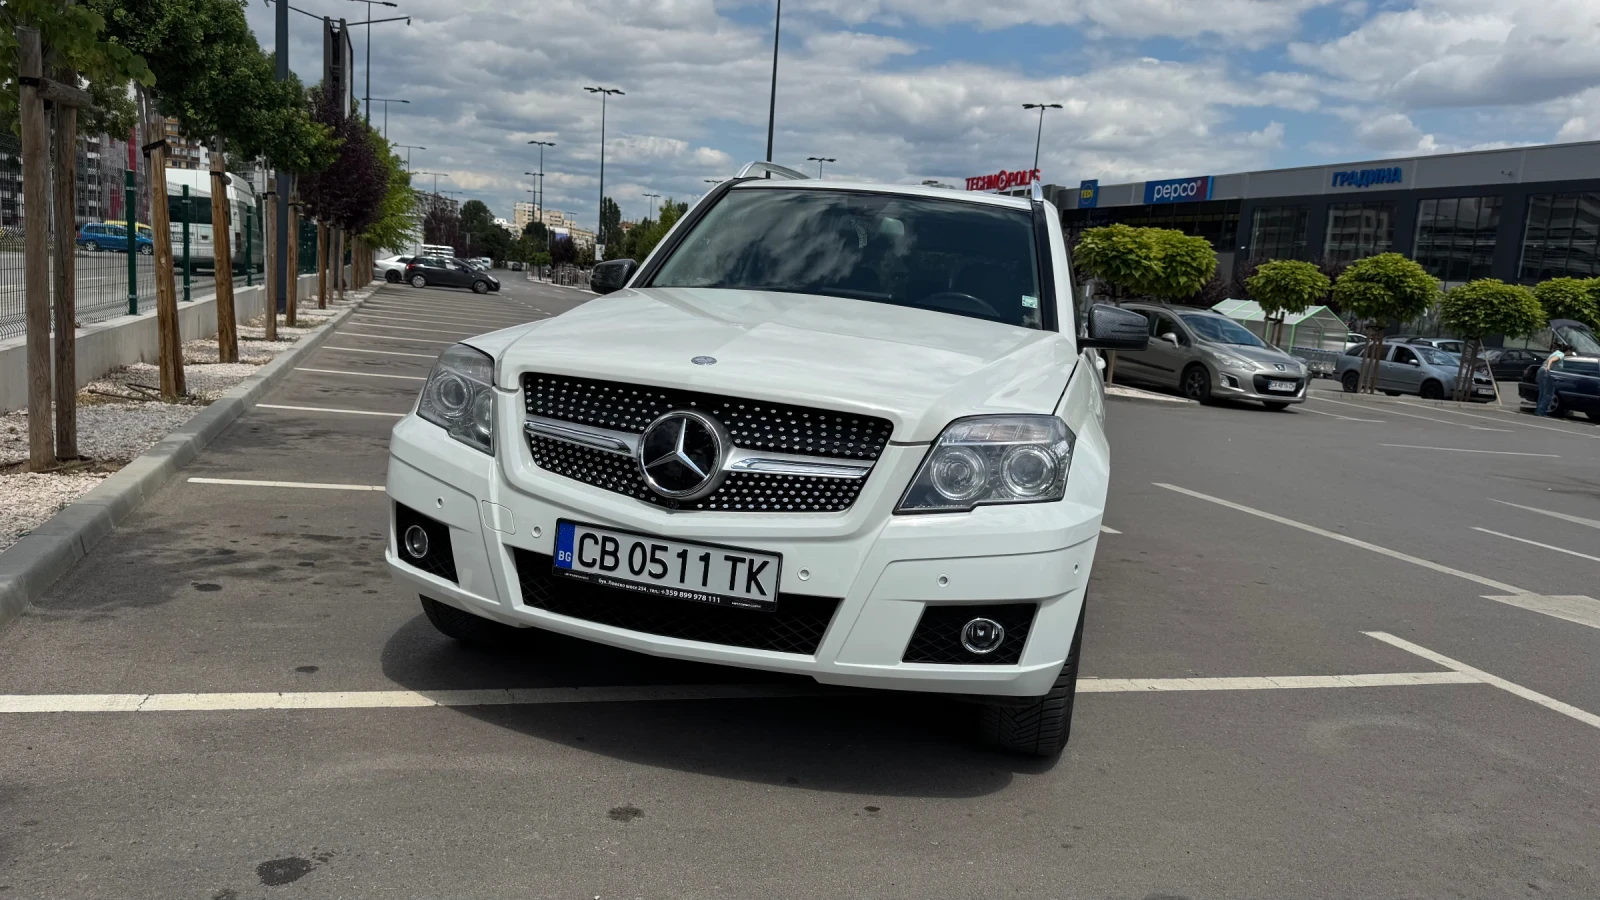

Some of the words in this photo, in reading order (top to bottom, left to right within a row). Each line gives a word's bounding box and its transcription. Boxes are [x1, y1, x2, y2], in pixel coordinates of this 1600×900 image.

[965, 168, 1041, 191] TECHNOPOLIS
[1331, 166, 1403, 188] ГРАДИНА
[1153, 181, 1198, 202] pepco
[558, 550, 572, 562] BG
[577, 532, 620, 572] CB
[628, 541, 711, 587] 0511
[724, 554, 770, 596] TK
[661, 588, 678, 596] +359
[679, 591, 693, 599] 899
[693, 593, 707, 601] 978
[708, 595, 720, 603] 111
